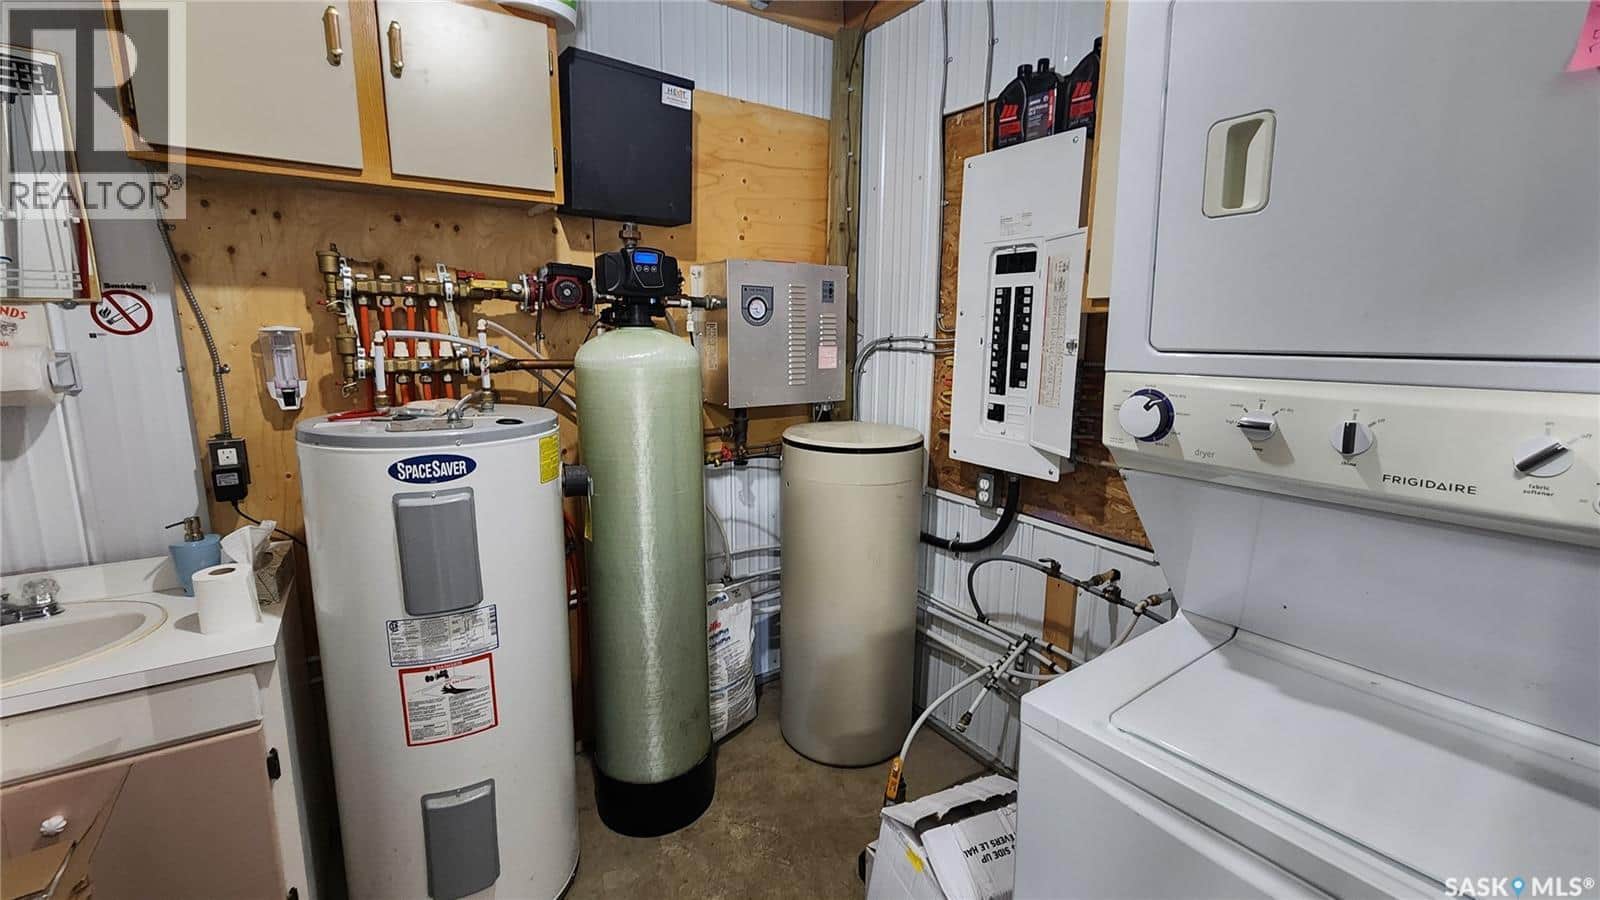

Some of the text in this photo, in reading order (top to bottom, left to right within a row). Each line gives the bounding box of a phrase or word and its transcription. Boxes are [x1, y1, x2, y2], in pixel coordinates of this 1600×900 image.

[1194, 448, 1215, 460] dryer
[1382, 473, 1478, 496] FRIGIDAIRE
[1528, 483, 1551, 491] fabric
[1522, 489, 1555, 497] softener
[978, 842, 990, 851] LE
[981, 846, 1011, 864] SIDE UP
